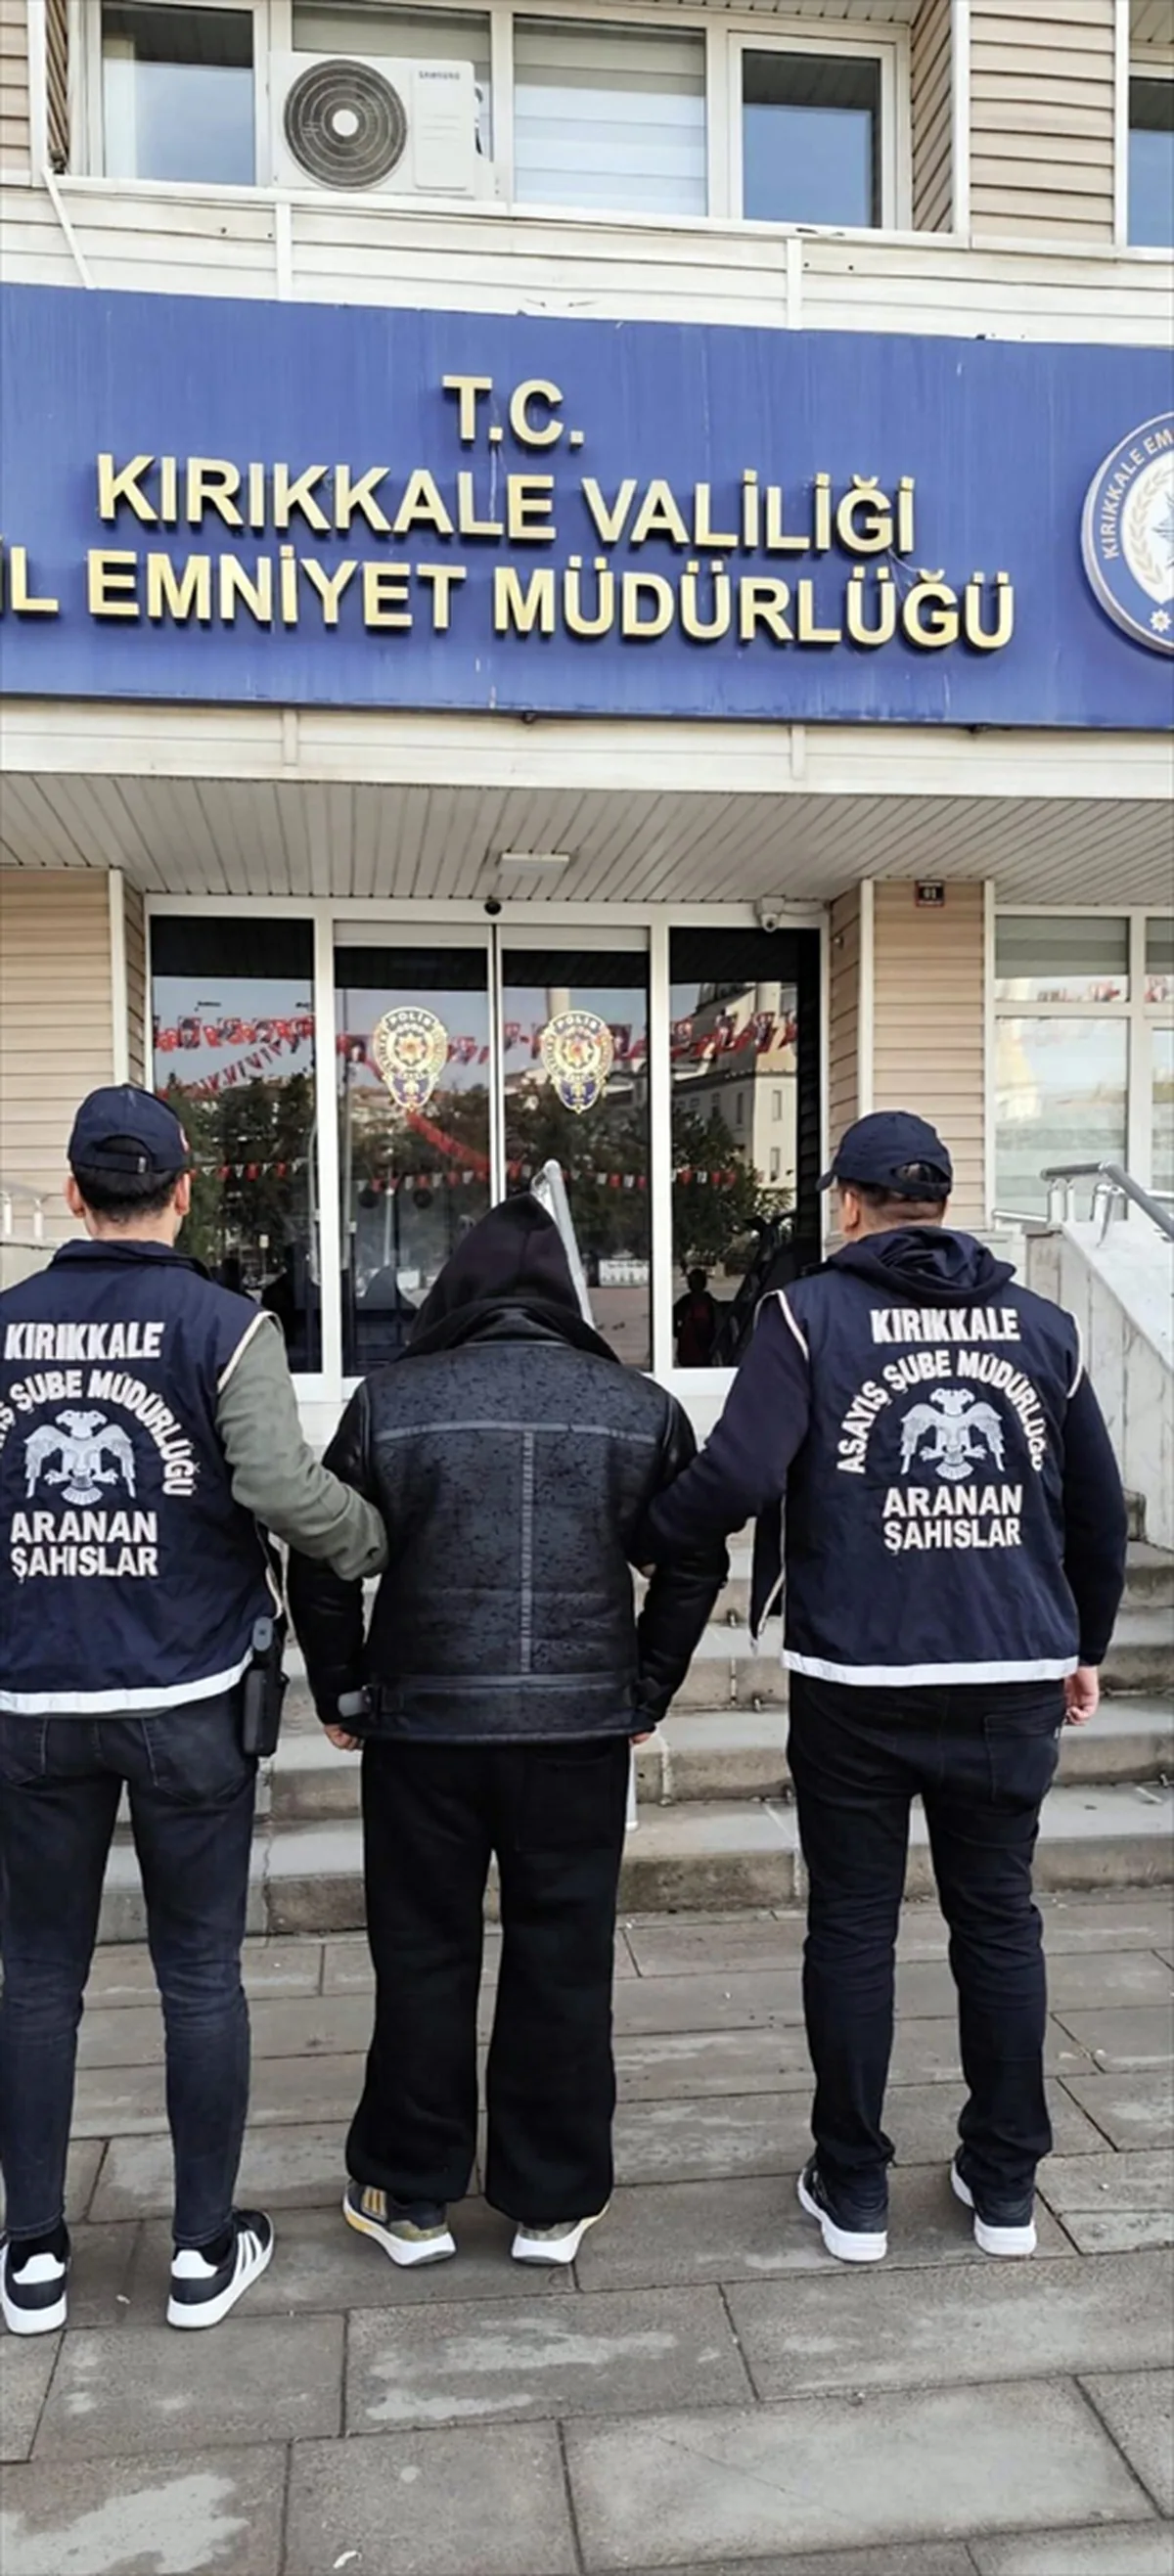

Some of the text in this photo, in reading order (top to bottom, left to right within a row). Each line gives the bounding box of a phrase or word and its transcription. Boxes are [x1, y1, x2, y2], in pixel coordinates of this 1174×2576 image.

[442, 375, 584, 445] T.C.
[98, 453, 915, 554] KIRIKKALE VALİLİĞİ
[1101, 448, 1144, 559] KIRIKKALE
[0, 533, 1014, 649] L EMNİYET MÜDÜRLÜĞÜ
[4, 1322, 165, 1360] KIRIKKALE
[870, 1307, 1021, 1343] KIRIKKALE
[10, 1370, 82, 1415] ŞUBE
[882, 1349, 952, 1394] ŞUBE
[881, 1484, 1023, 1517] ARANAN
[10, 1511, 158, 1543] ARANAN
[883, 1517, 1022, 1556] ŞAHISLAR
[11, 1546, 159, 1584] ŞAHISLAR
